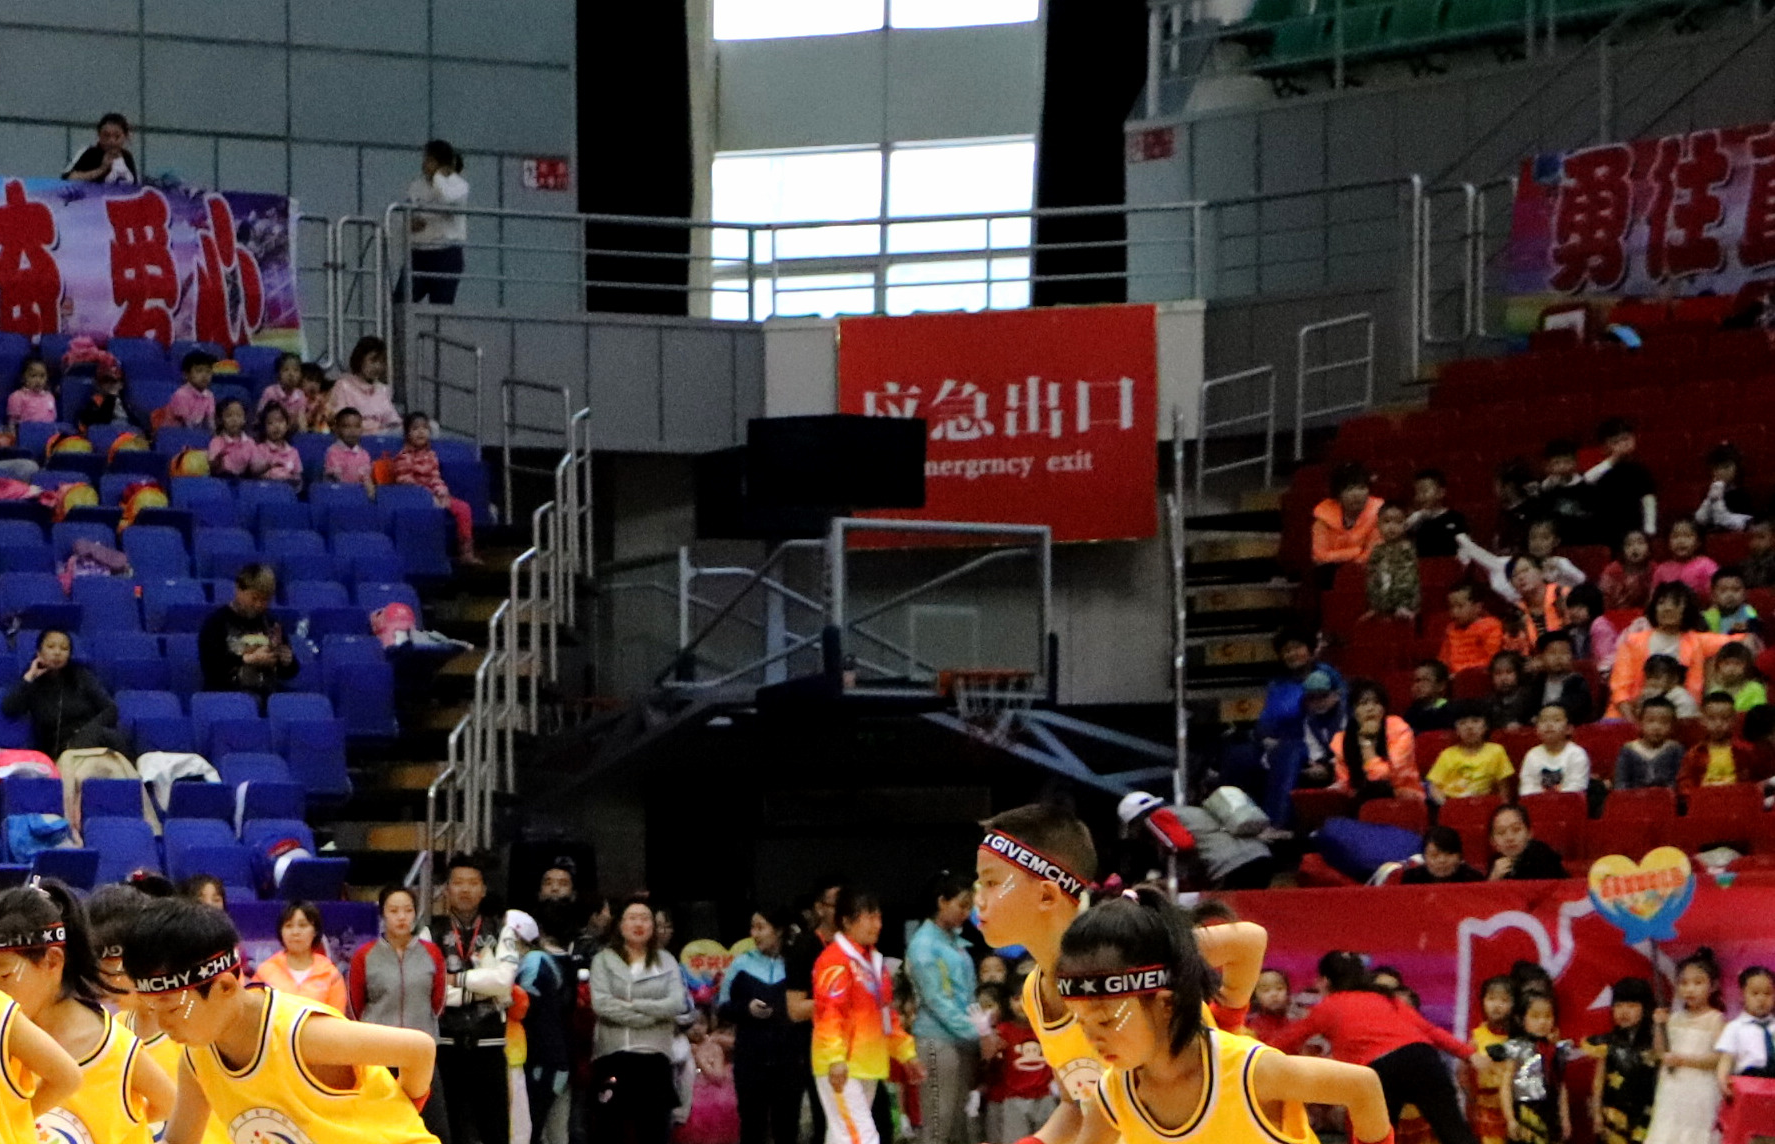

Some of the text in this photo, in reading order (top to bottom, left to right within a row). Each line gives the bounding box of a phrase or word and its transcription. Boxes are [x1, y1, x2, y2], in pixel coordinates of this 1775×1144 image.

[863, 376, 1135, 440] 应急出口
[1046, 450, 1093, 473] exit
[990, 834, 1082, 895] GIVEMCHY
